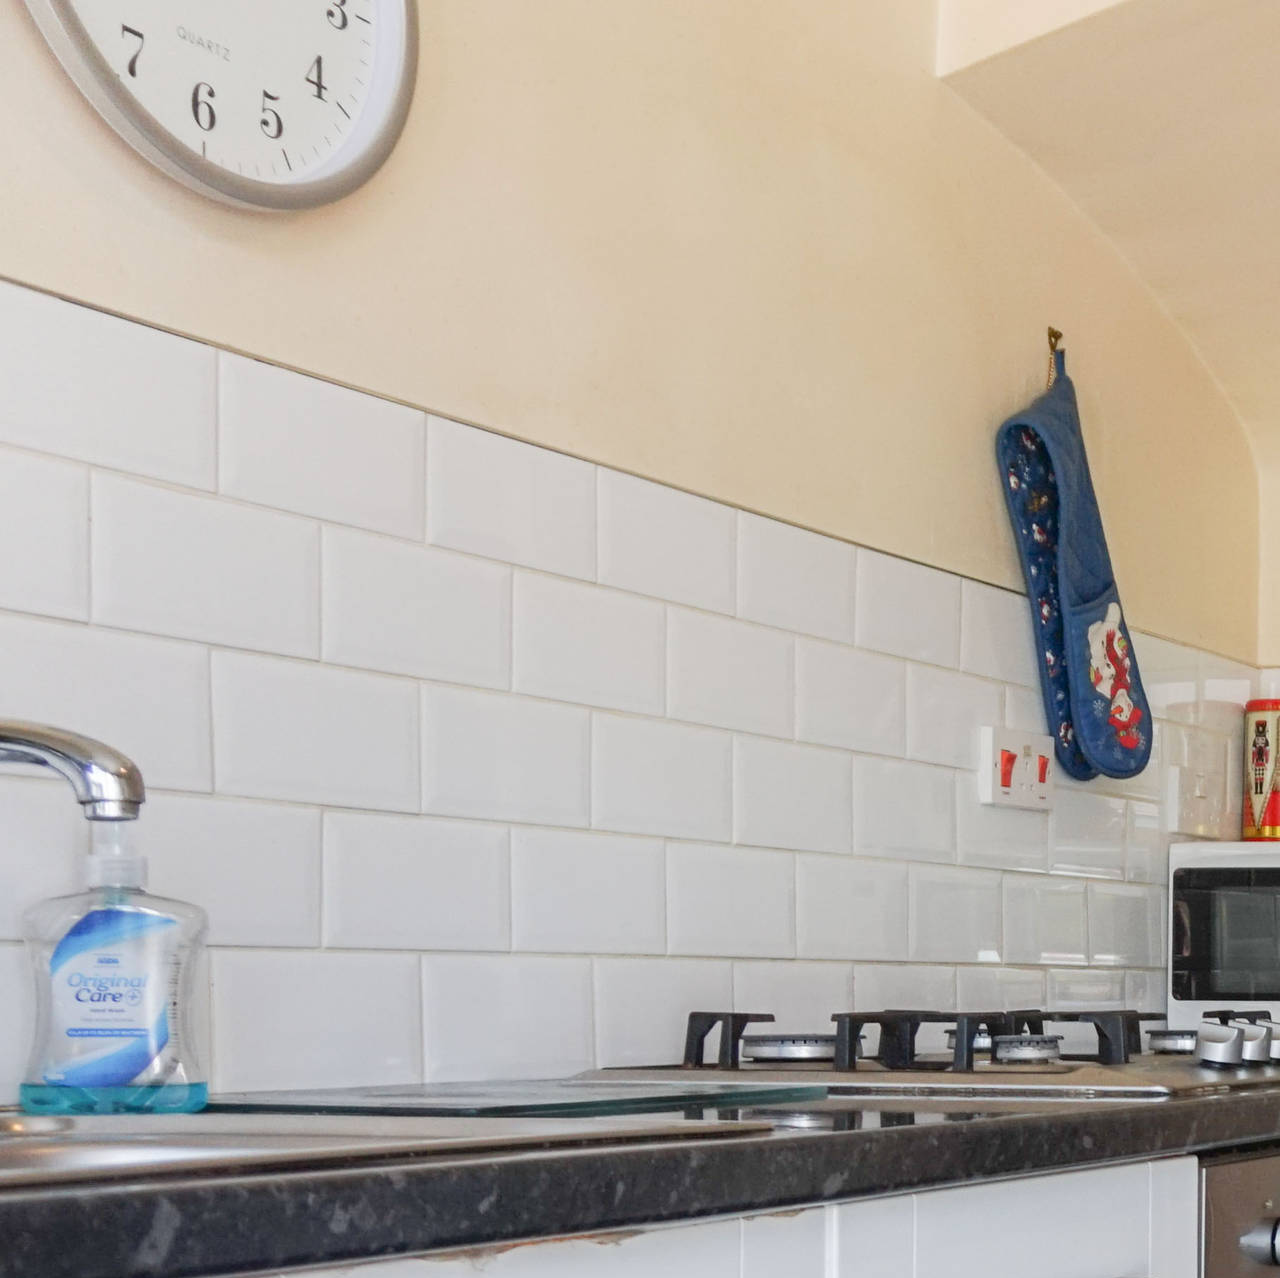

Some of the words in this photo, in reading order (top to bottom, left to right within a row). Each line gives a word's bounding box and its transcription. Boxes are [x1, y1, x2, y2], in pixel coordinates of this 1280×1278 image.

[326, 0, 348, 30] 3
[120, 24, 145, 78] 7
[175, 25, 232, 62] QUARTZ
[304, 55, 328, 101] 4
[191, 82, 216, 131] 6
[260, 89, 283, 139] 5
[67, 972, 147, 991] Original
[75, 988, 123, 1003] Care
